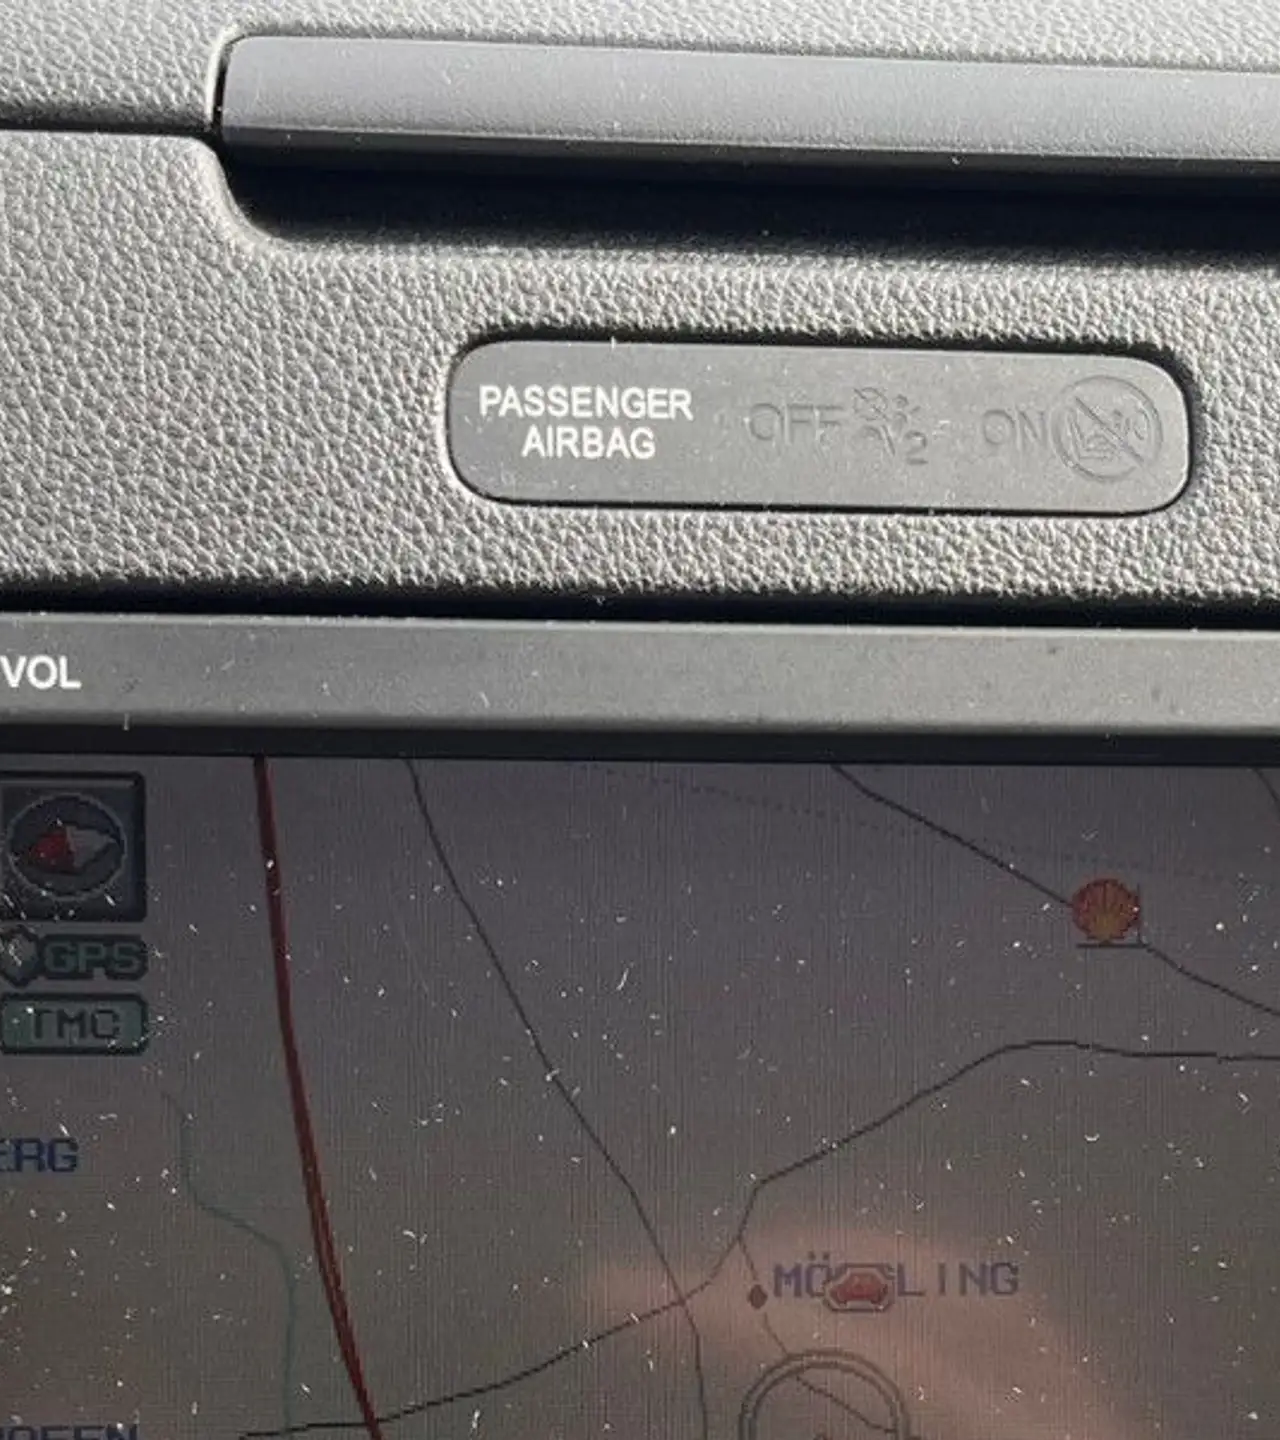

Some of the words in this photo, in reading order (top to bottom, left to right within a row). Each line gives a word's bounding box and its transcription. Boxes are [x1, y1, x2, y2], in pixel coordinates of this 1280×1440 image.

[480, 384, 693, 421] PASSENGER
[522, 426, 656, 459] AIRBAG
[0, 655, 81, 690] VOL
[45, 941, 140, 972] GPS
[22, 1008, 120, 1040] TMC
[773, 1251, 1018, 1297] MÖLING
